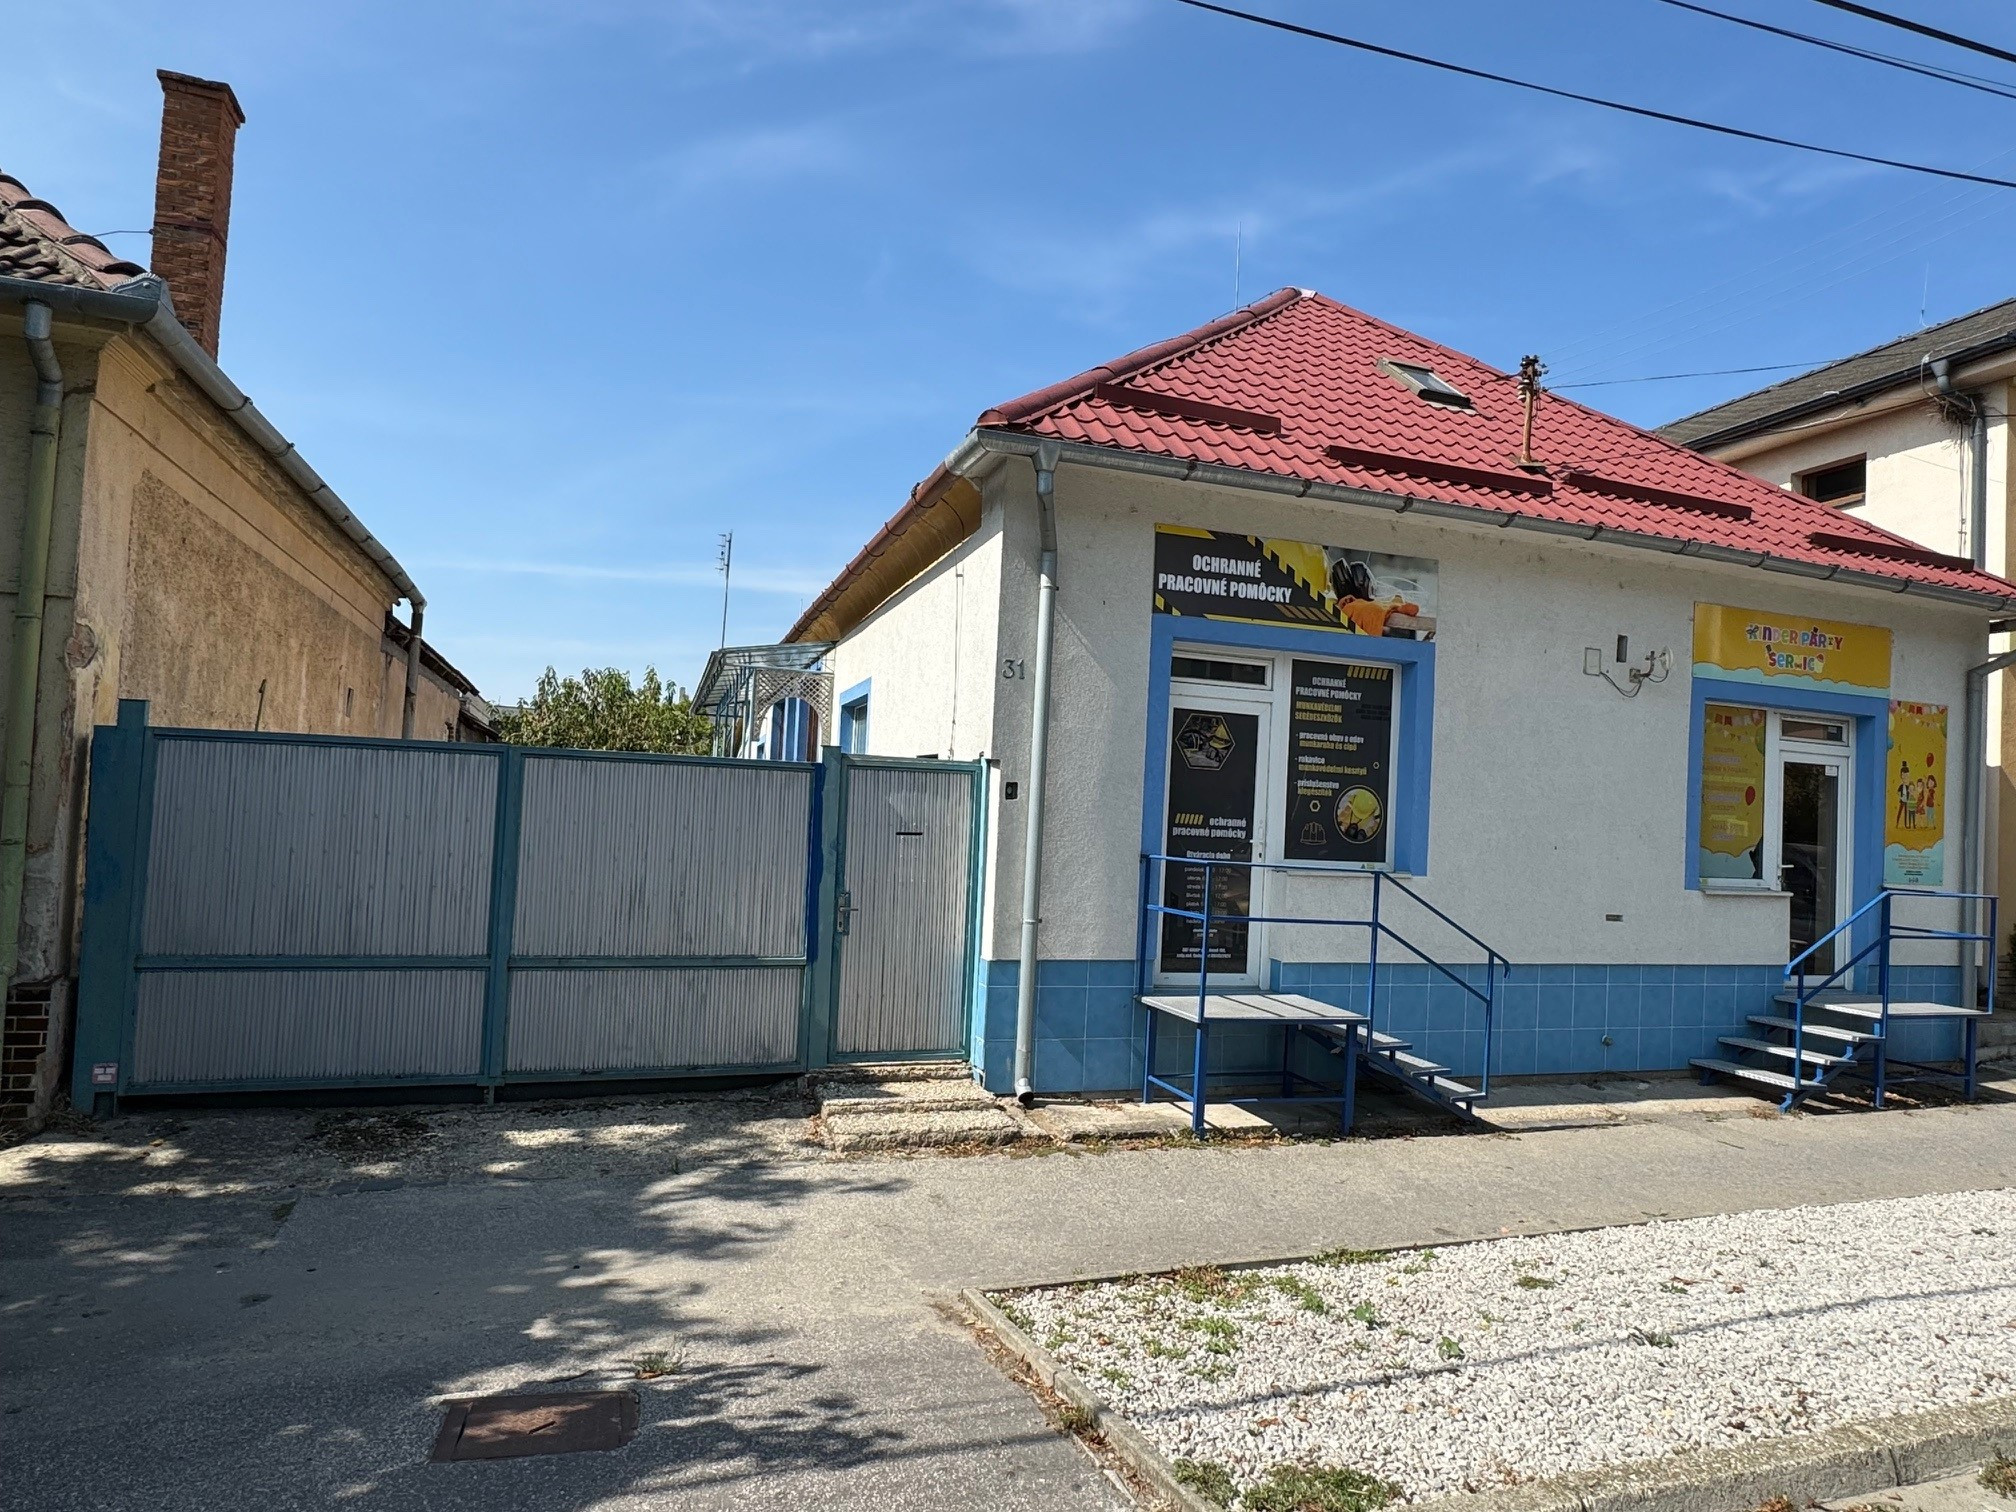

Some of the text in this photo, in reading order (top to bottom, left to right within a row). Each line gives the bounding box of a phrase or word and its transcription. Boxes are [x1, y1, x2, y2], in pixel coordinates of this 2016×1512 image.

[1192, 554, 1262, 578] OCHRANNÉ
[1158, 573, 1293, 604] PRACOVNÉ POMÔCKY
[1002, 659, 1025, 680] 31
[1312, 677, 1347, 688] OCHRANNÉ
[1295, 686, 1330, 698] PRACOVNÉ
[1209, 817, 1246, 828] ochranné
[1172, 826, 1210, 837] pracovné
